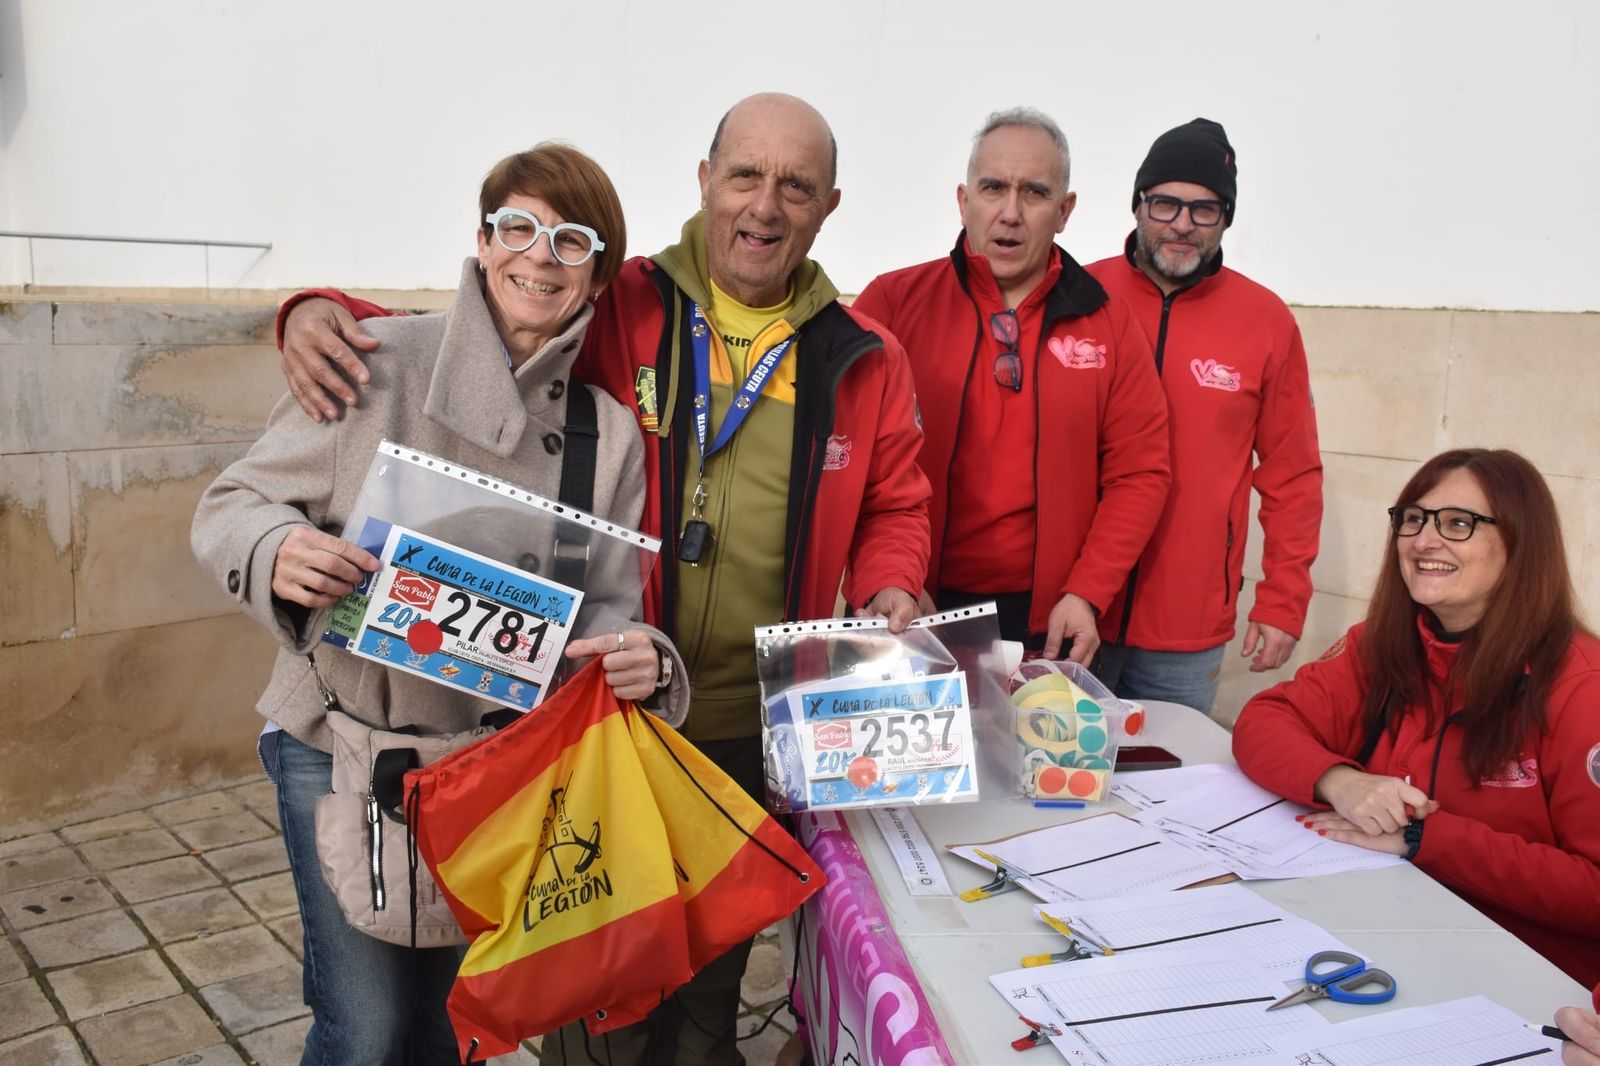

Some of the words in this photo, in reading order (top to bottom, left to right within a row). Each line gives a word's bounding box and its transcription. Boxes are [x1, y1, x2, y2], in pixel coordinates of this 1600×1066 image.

[745, 364, 769, 393] CEUTA
[696, 412, 706, 444] CEUTA
[398, 544, 424, 563] X
[392, 579, 410, 593] San
[411, 586, 436, 602] Pablo
[378, 602, 432, 630] 20
[438, 591, 550, 664] 2781
[455, 640, 479, 654] PILAR
[809, 697, 824, 718] X
[814, 731, 829, 742] San
[831, 729, 851, 741] Pablo
[860, 711, 955, 758] 2537
